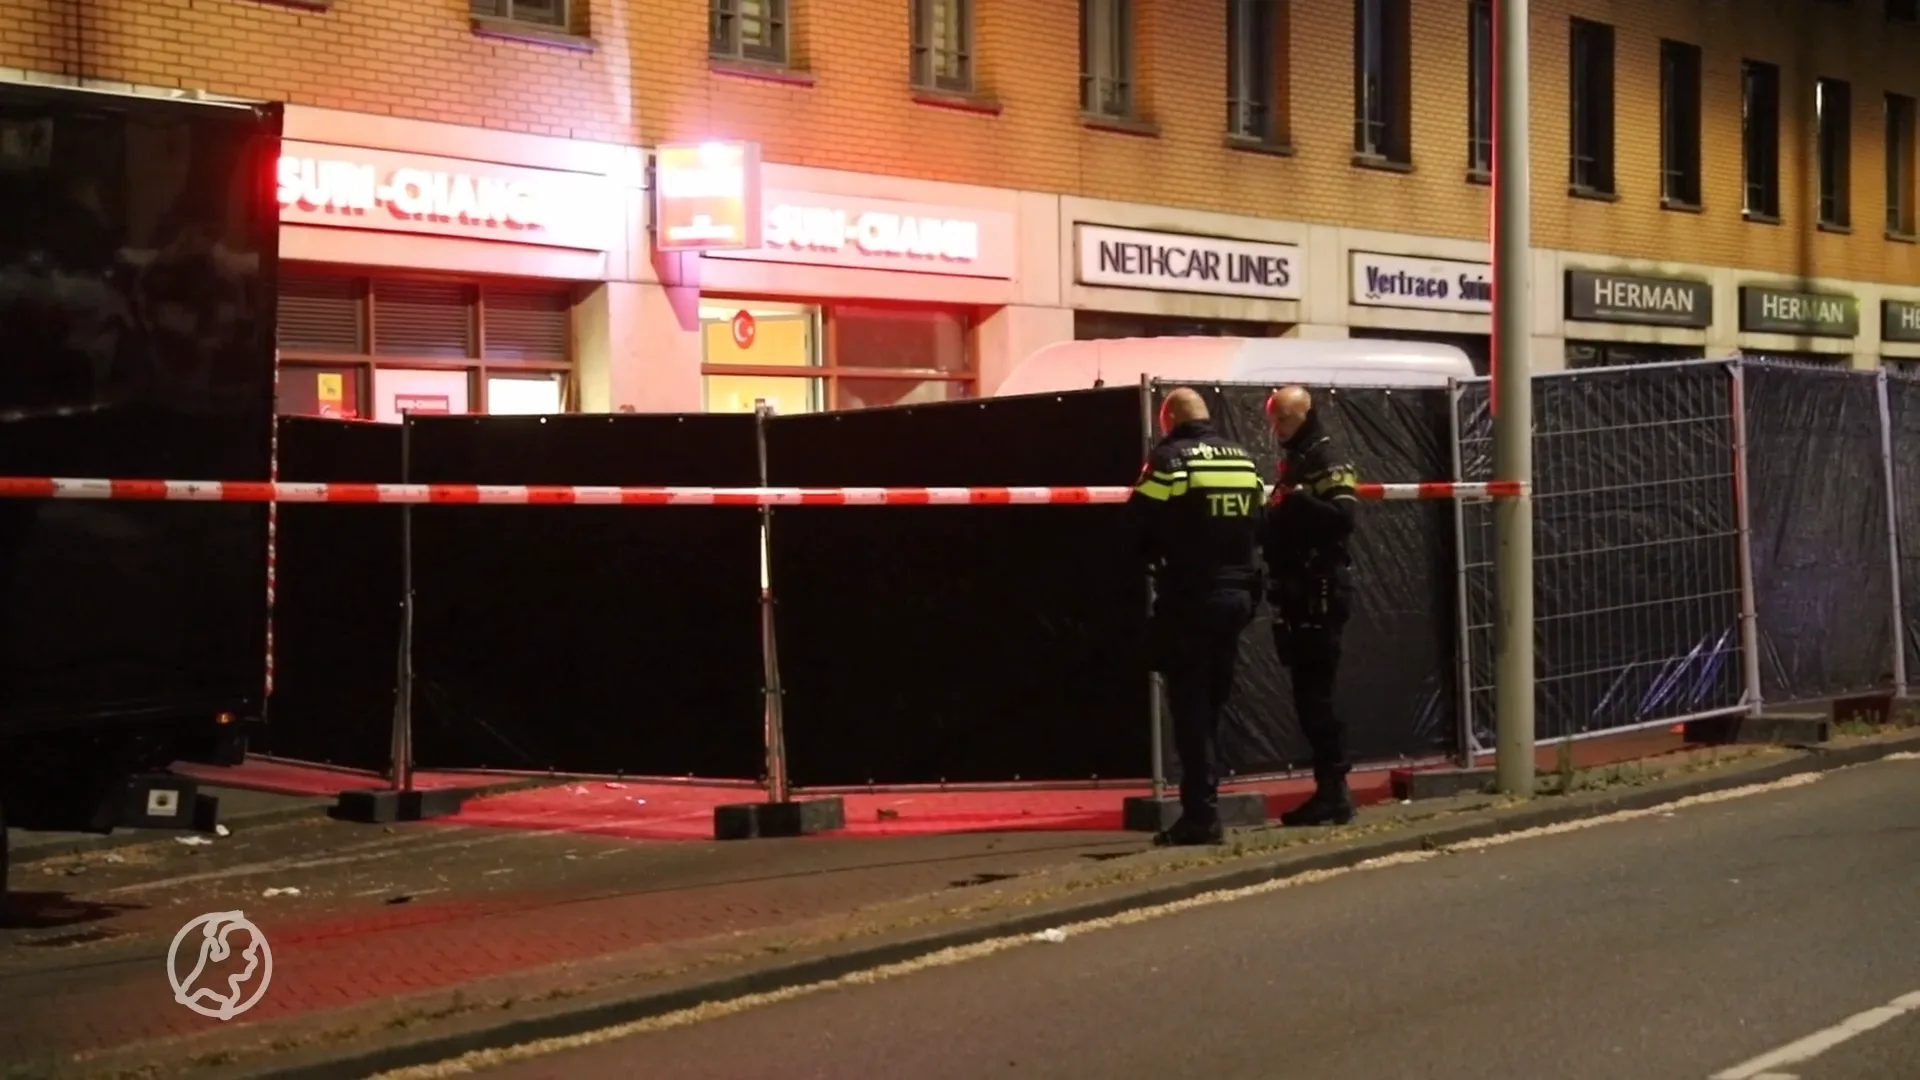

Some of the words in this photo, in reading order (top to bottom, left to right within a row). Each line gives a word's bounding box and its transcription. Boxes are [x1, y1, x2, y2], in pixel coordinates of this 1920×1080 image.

[1100, 240, 1220, 281] NETHCAR
[1228, 252, 1290, 287] LINES
[1366, 265, 1449, 299] Vertraco
[1594, 278, 1694, 313] HERMAN
[1762, 294, 1844, 325] HERMAN
[1206, 493, 1250, 517] TEV
